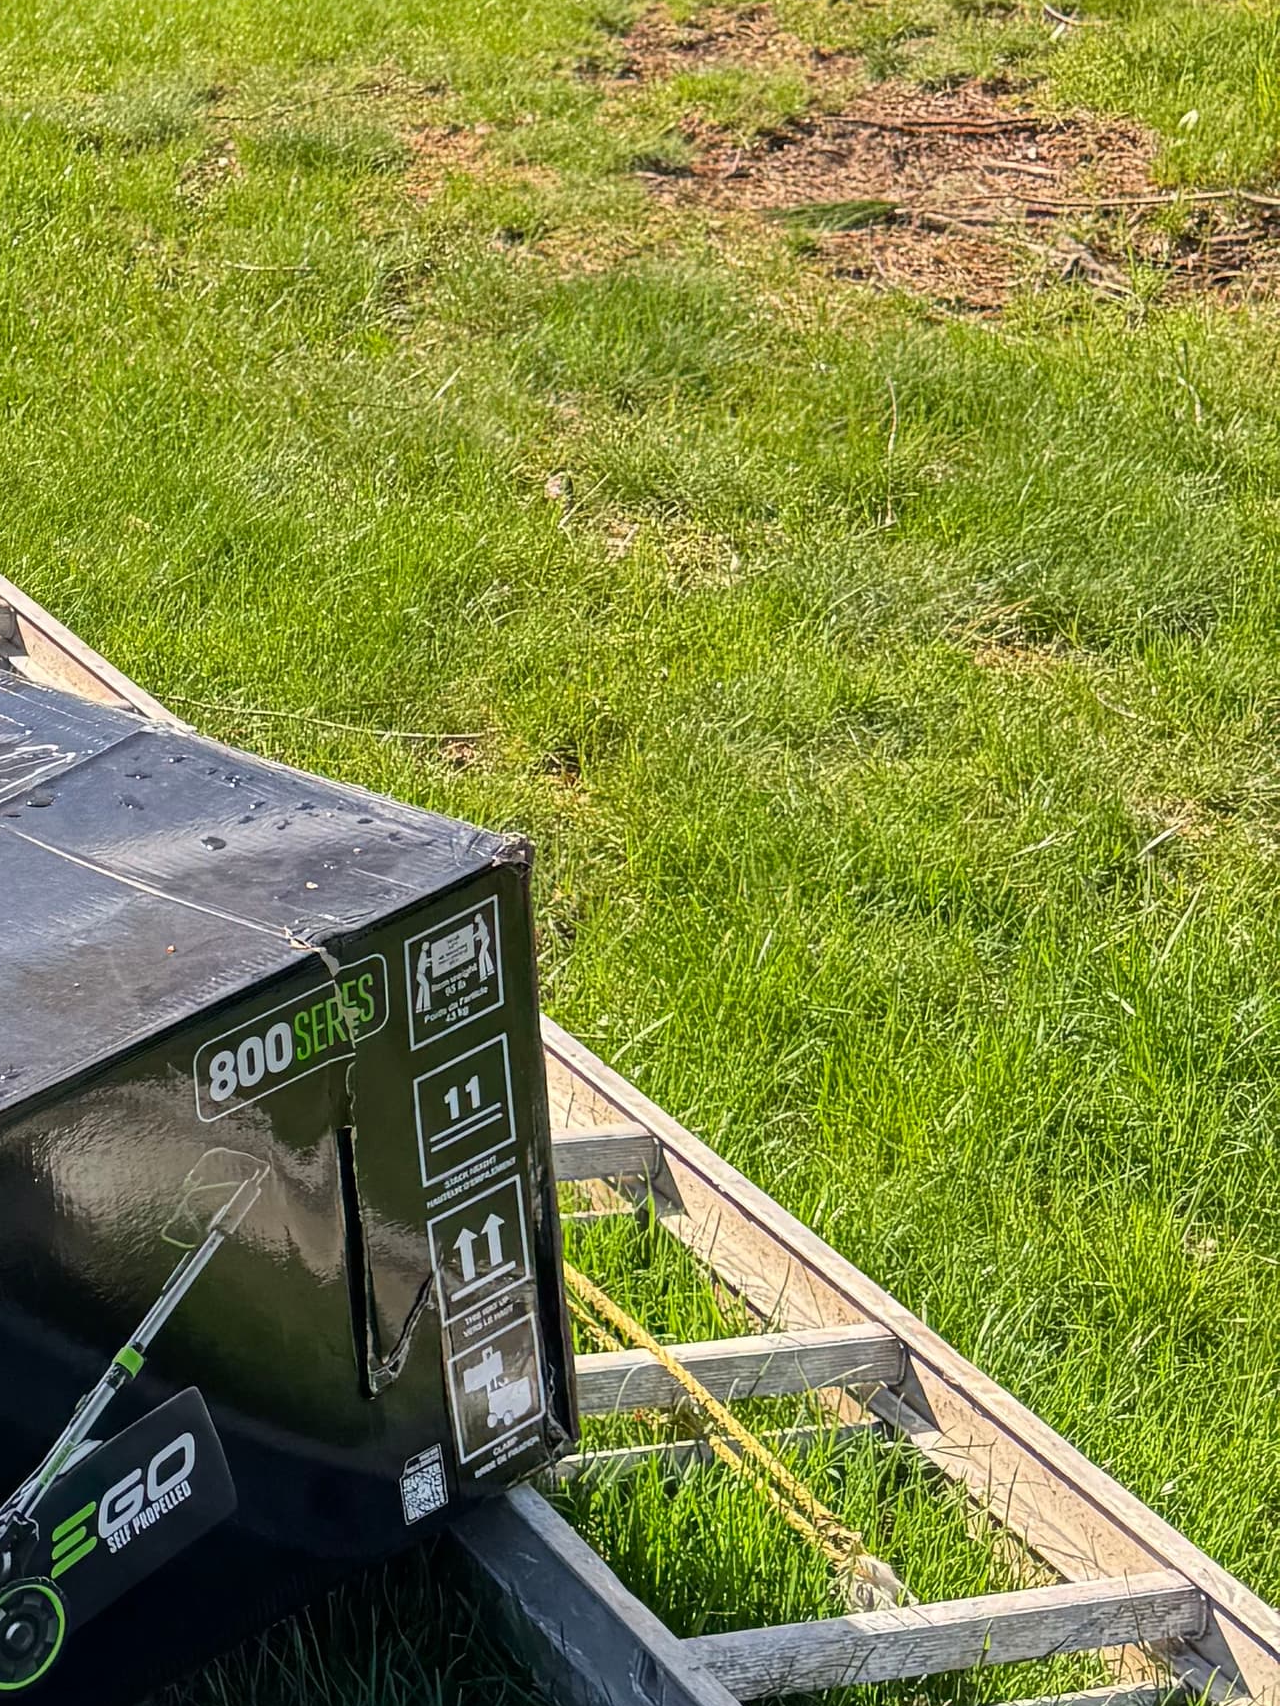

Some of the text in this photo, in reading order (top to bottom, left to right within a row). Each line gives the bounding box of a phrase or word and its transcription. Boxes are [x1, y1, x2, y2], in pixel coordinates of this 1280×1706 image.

[443, 1074, 481, 1121] 11
[51, 1433, 195, 1579] EGO
[107, 1481, 191, 1553] SELF PROPELLED
